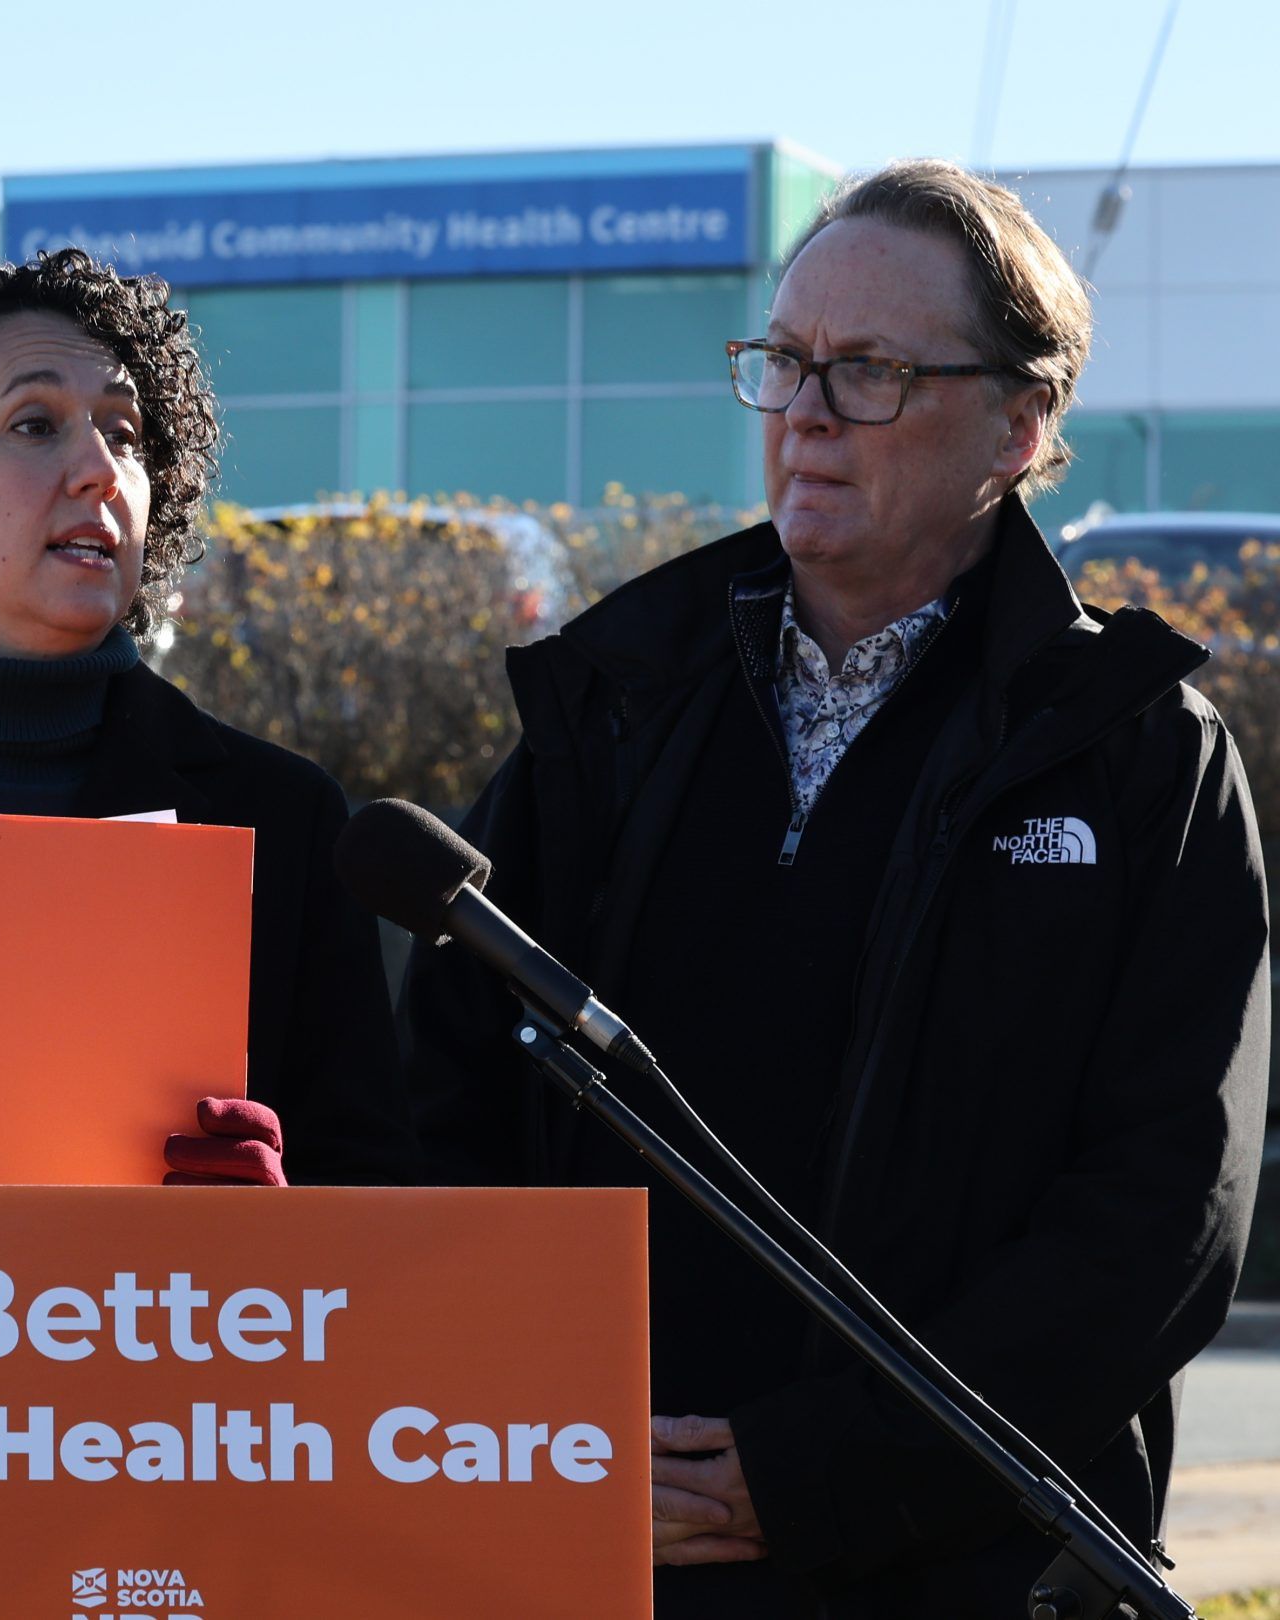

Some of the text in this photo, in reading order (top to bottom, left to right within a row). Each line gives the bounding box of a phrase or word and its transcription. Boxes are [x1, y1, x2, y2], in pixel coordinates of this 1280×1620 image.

[211, 212, 438, 260] Community
[445, 206, 582, 249] Health
[588, 204, 729, 245] Centre
[1023, 817, 1063, 834] THE
[992, 832, 1062, 851] NORTH
[1011, 848, 1062, 864] FACE
[367, 1406, 613, 1483] Care
[117, 1569, 186, 1587] NOVA
[117, 1589, 204, 1607] SCOTIA
